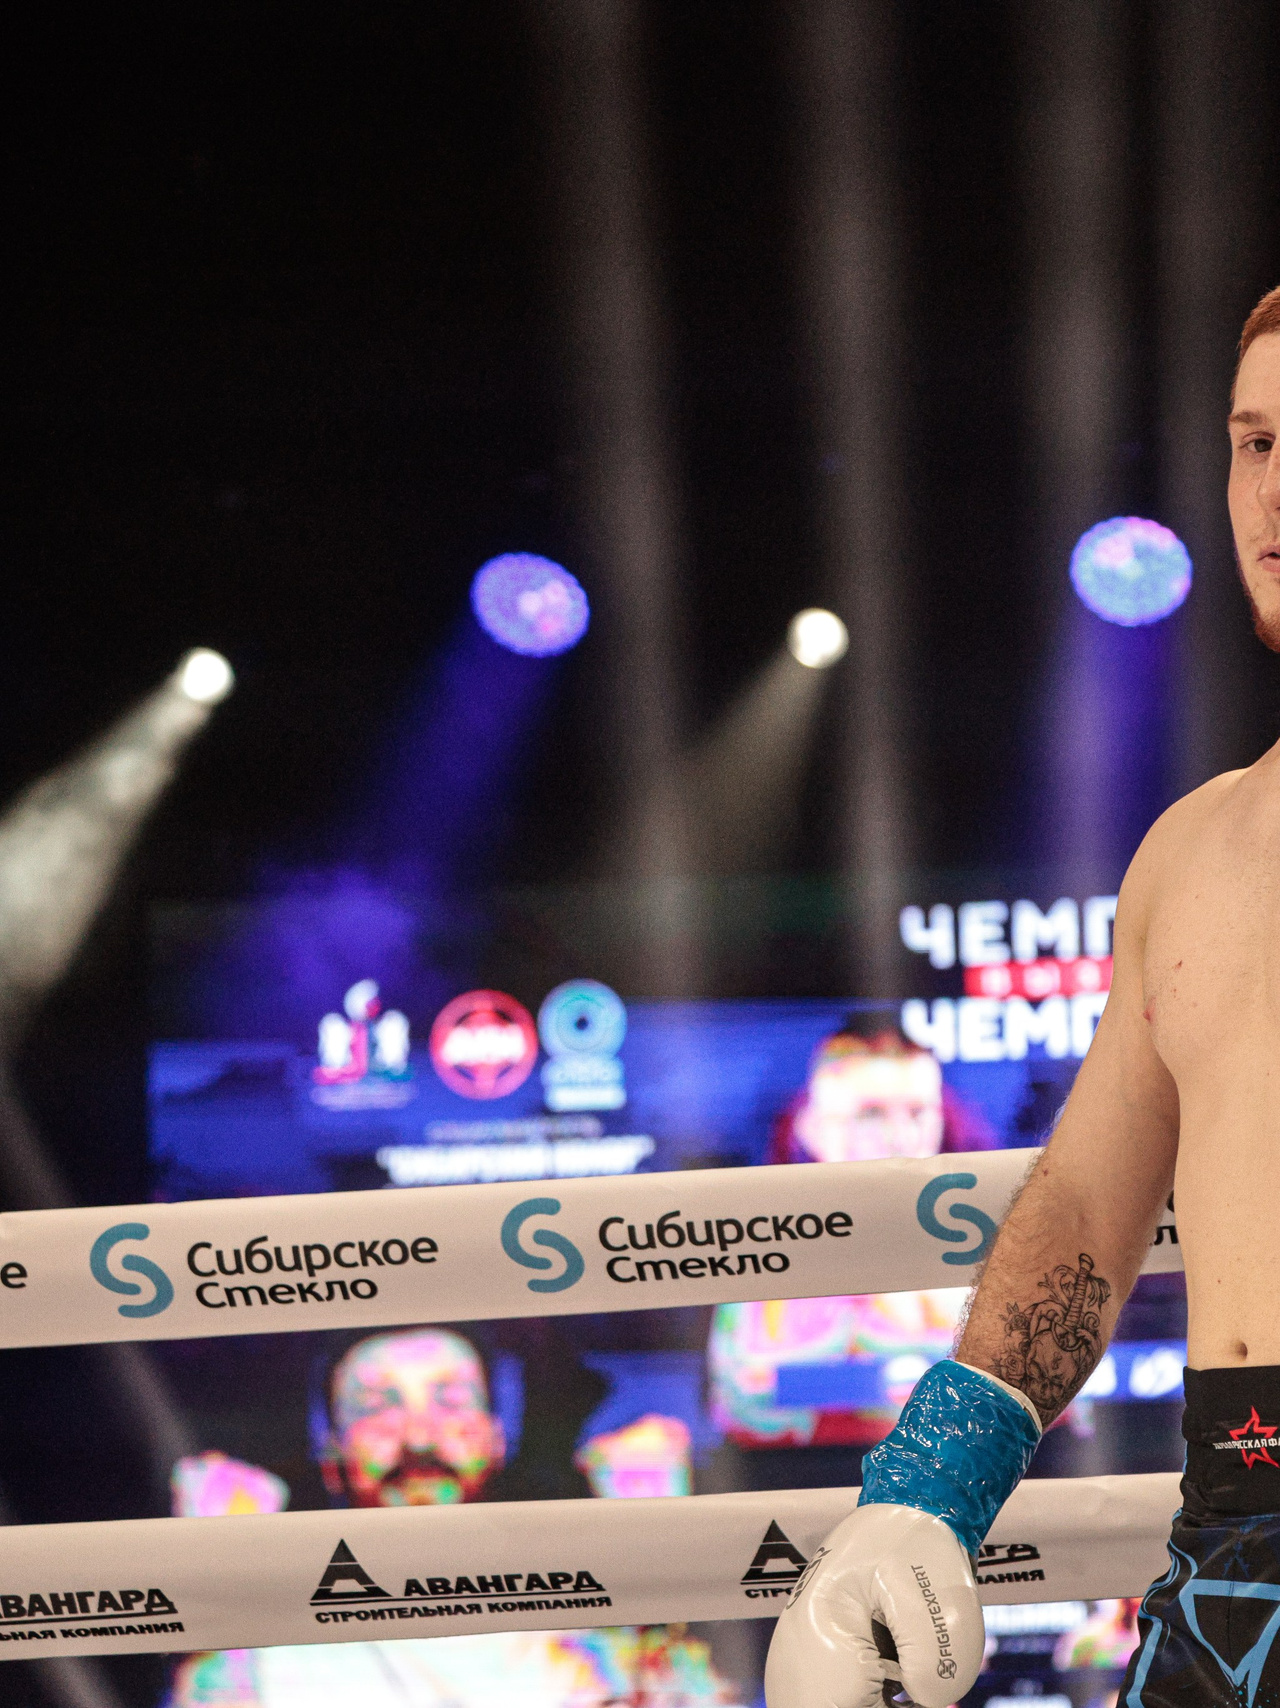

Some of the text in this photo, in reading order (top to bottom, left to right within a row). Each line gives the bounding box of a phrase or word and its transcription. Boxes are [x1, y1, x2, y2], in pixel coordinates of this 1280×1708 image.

[598, 1210, 854, 1252] Сибирское
[187, 1235, 439, 1277] Сибирское
[606, 1252, 790, 1283] Стекло
[195, 1278, 378, 1308] Стекло
[404, 1571, 606, 1597] АВАНГАРД
[0, 1589, 178, 1619] ВАНГАРД
[315, 1596, 613, 1624] СТРОИТЕЛЬНАЯ КОМПАНИЯ
[911, 1565, 952, 1658] FIGHTEXPERT
[60, 1621, 185, 1639] КОМПАНИЯ
